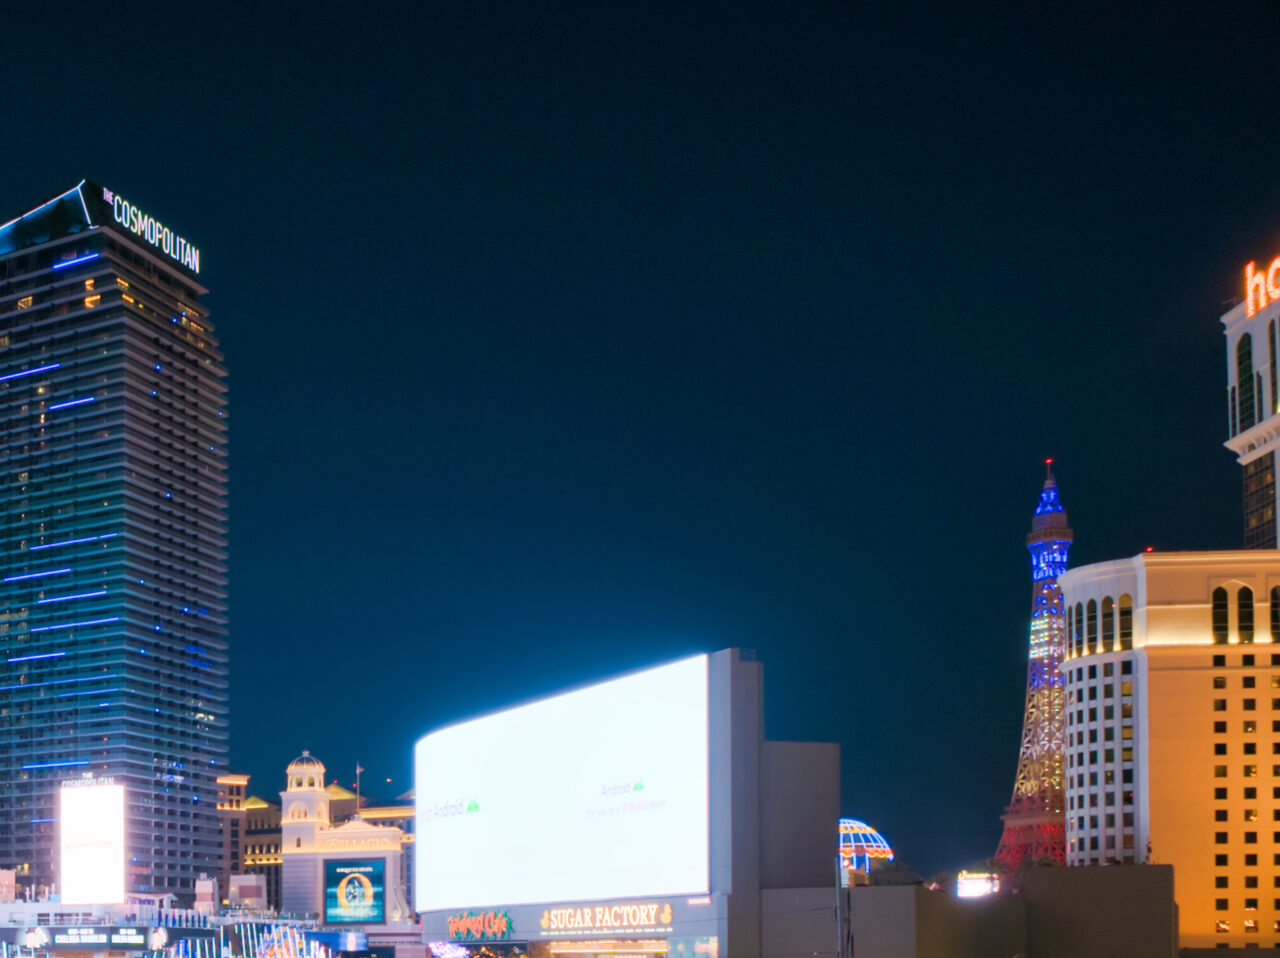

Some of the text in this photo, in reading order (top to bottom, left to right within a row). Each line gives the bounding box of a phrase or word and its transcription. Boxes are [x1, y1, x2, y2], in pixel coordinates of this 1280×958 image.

[103, 187, 200, 273] THE COSMOPOLITAN
[550, 904, 659, 929] SUGAR FACTORY
